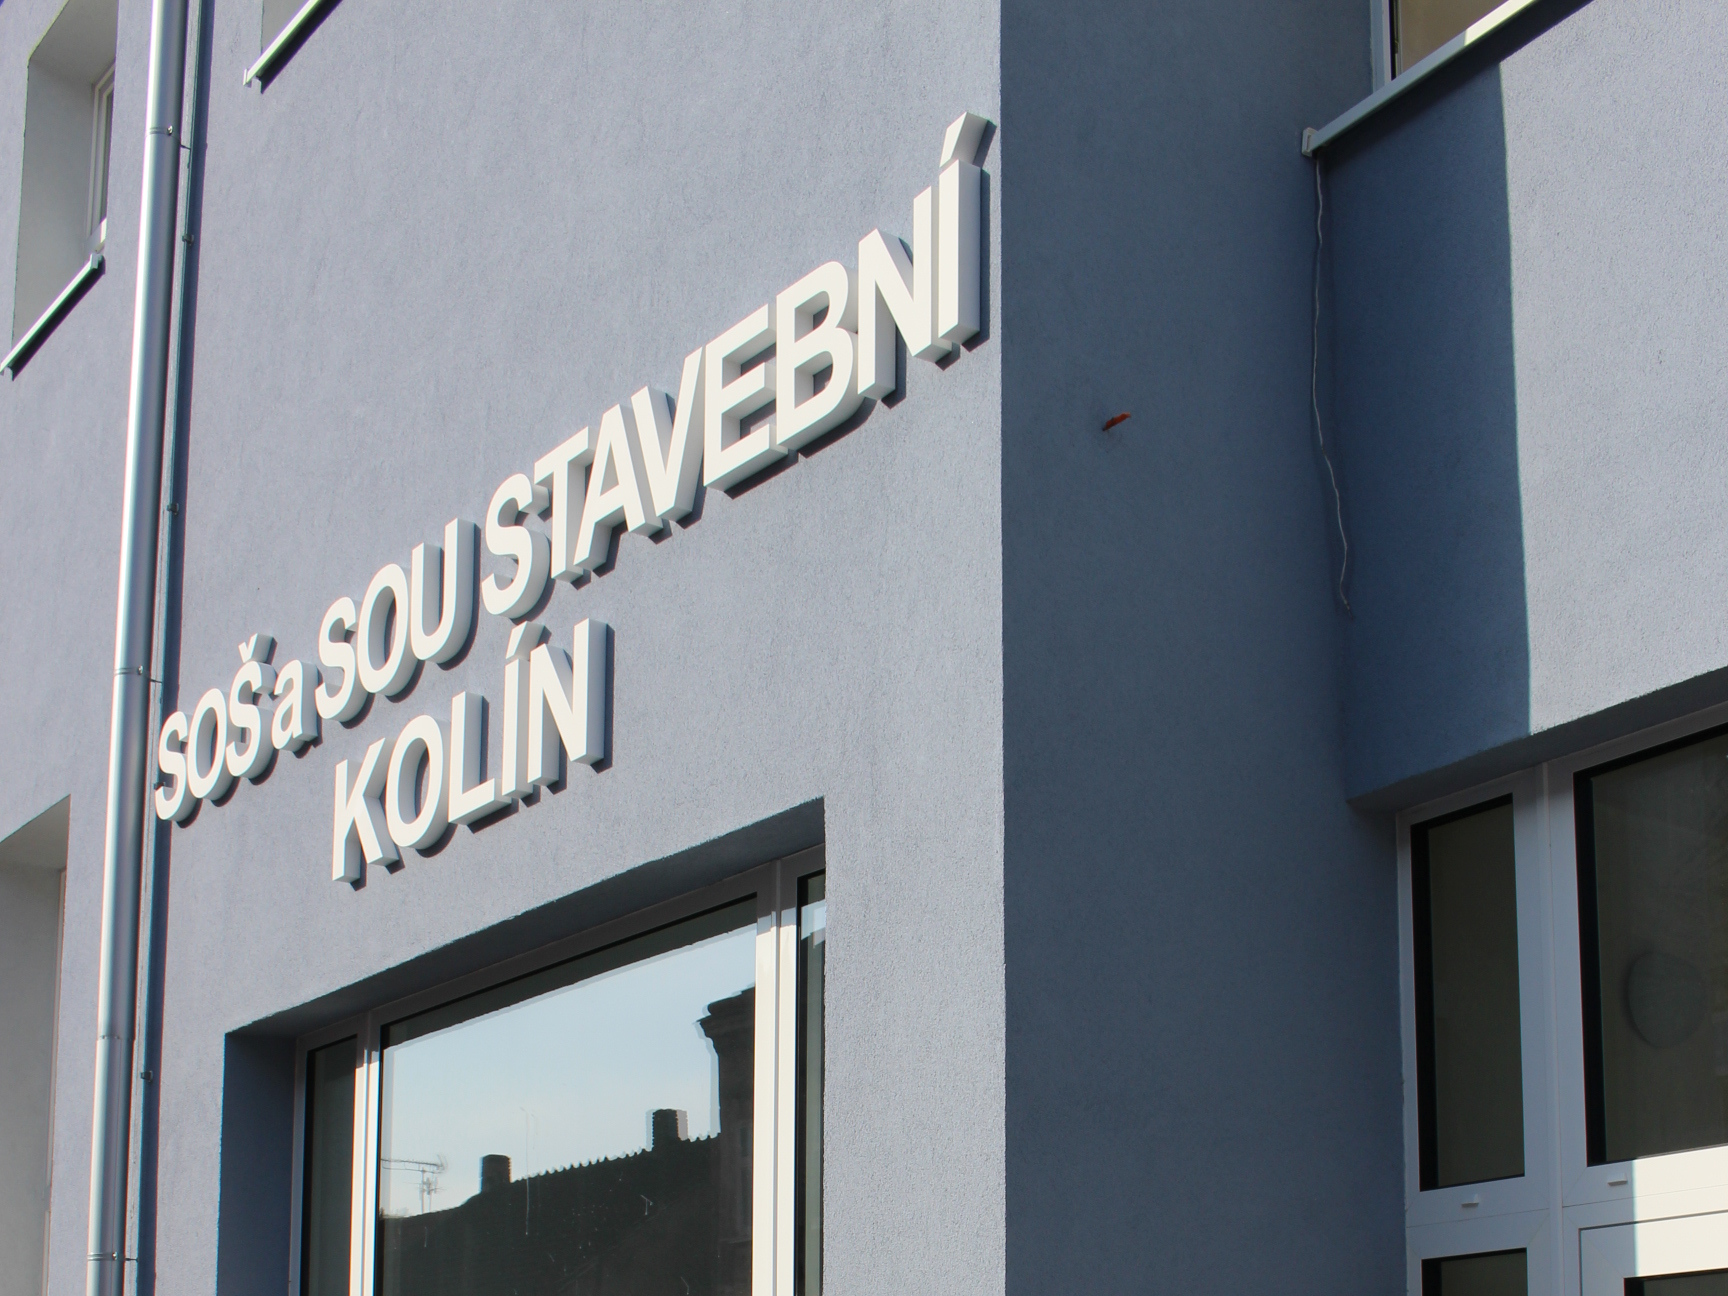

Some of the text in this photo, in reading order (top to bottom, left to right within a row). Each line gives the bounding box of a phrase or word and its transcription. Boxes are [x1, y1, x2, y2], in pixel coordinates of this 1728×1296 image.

[155, 111, 994, 822] SOŠ a SOU STAVEBNÍ
[332, 618, 608, 883] KOLÍN
